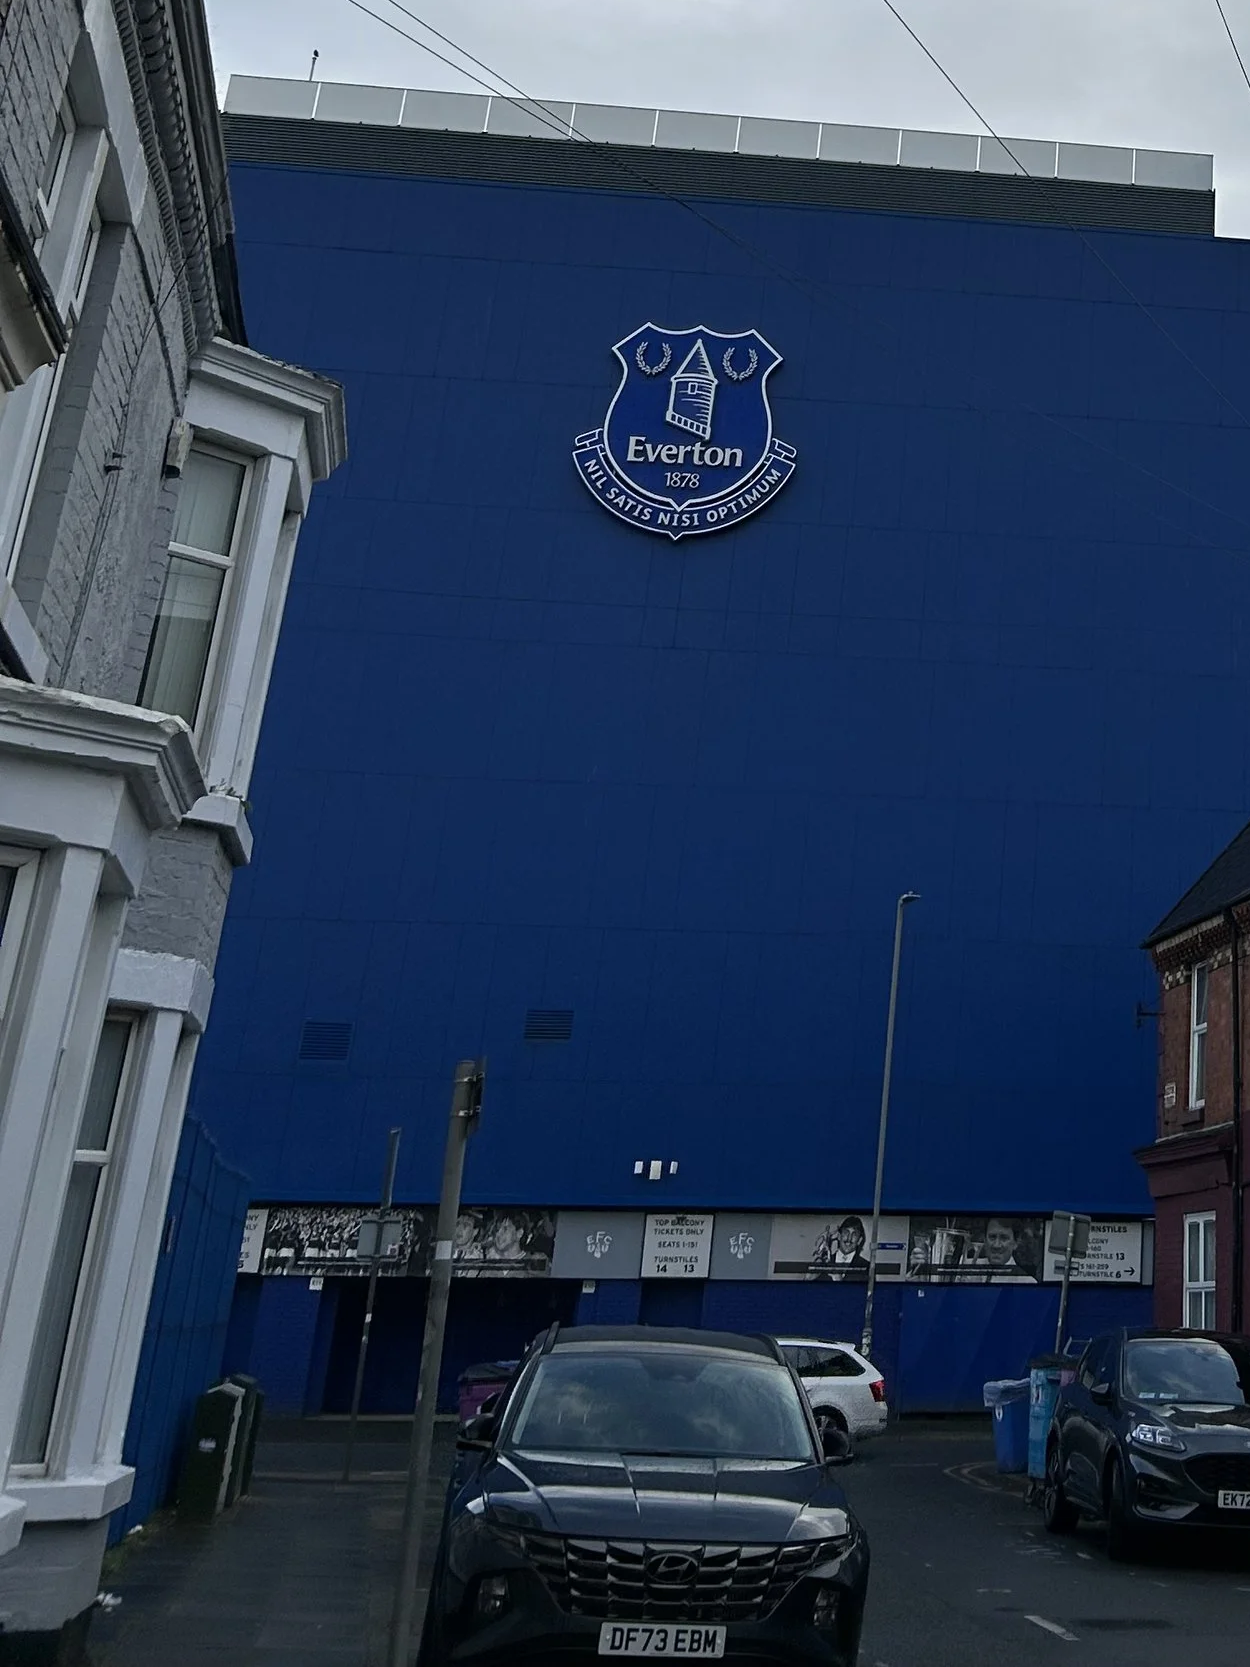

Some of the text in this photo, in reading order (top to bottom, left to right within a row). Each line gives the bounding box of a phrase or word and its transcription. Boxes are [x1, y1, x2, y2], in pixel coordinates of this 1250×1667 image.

[627, 436, 743, 467] Everton
[664, 472, 700, 488] 1878
[584, 459, 782, 527] NIL SATIS NISI OPTIMUM
[587, 1231, 612, 1245] EFC
[730, 1233, 755, 1245] EFC
[1116, 1252, 1125, 1261] 13
[656, 1264, 695, 1273] 14 13
[609, 1627, 718, 1653] DF73 EBM
